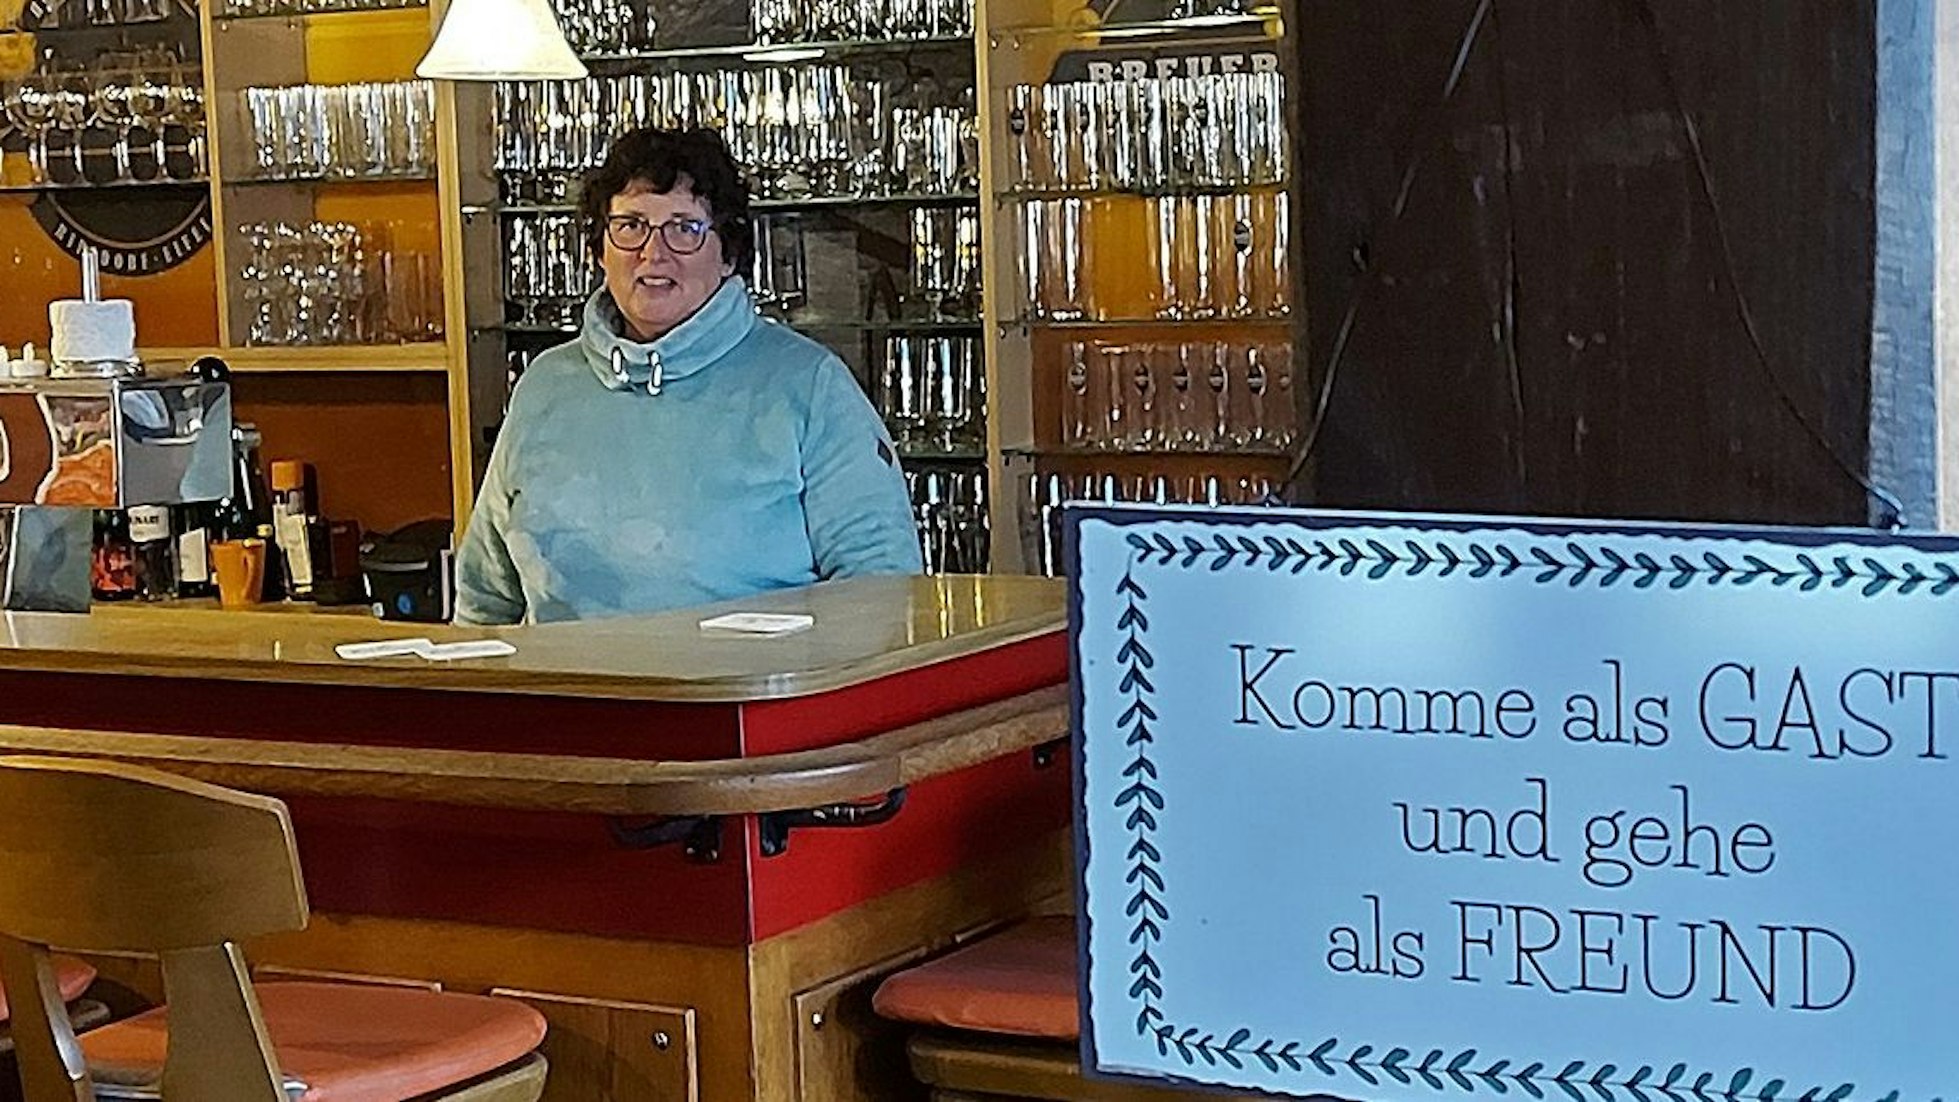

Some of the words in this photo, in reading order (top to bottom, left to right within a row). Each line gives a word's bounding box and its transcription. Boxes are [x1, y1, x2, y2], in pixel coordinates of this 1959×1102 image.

[1230, 643, 1537, 739] Komme
[1562, 658, 1669, 747] als
[1699, 662, 1959, 760] GAST
[1391, 777, 1561, 863] und
[1583, 784, 1776, 888] gehe
[1326, 894, 1425, 979] als
[1449, 900, 1856, 1011] FREUND
